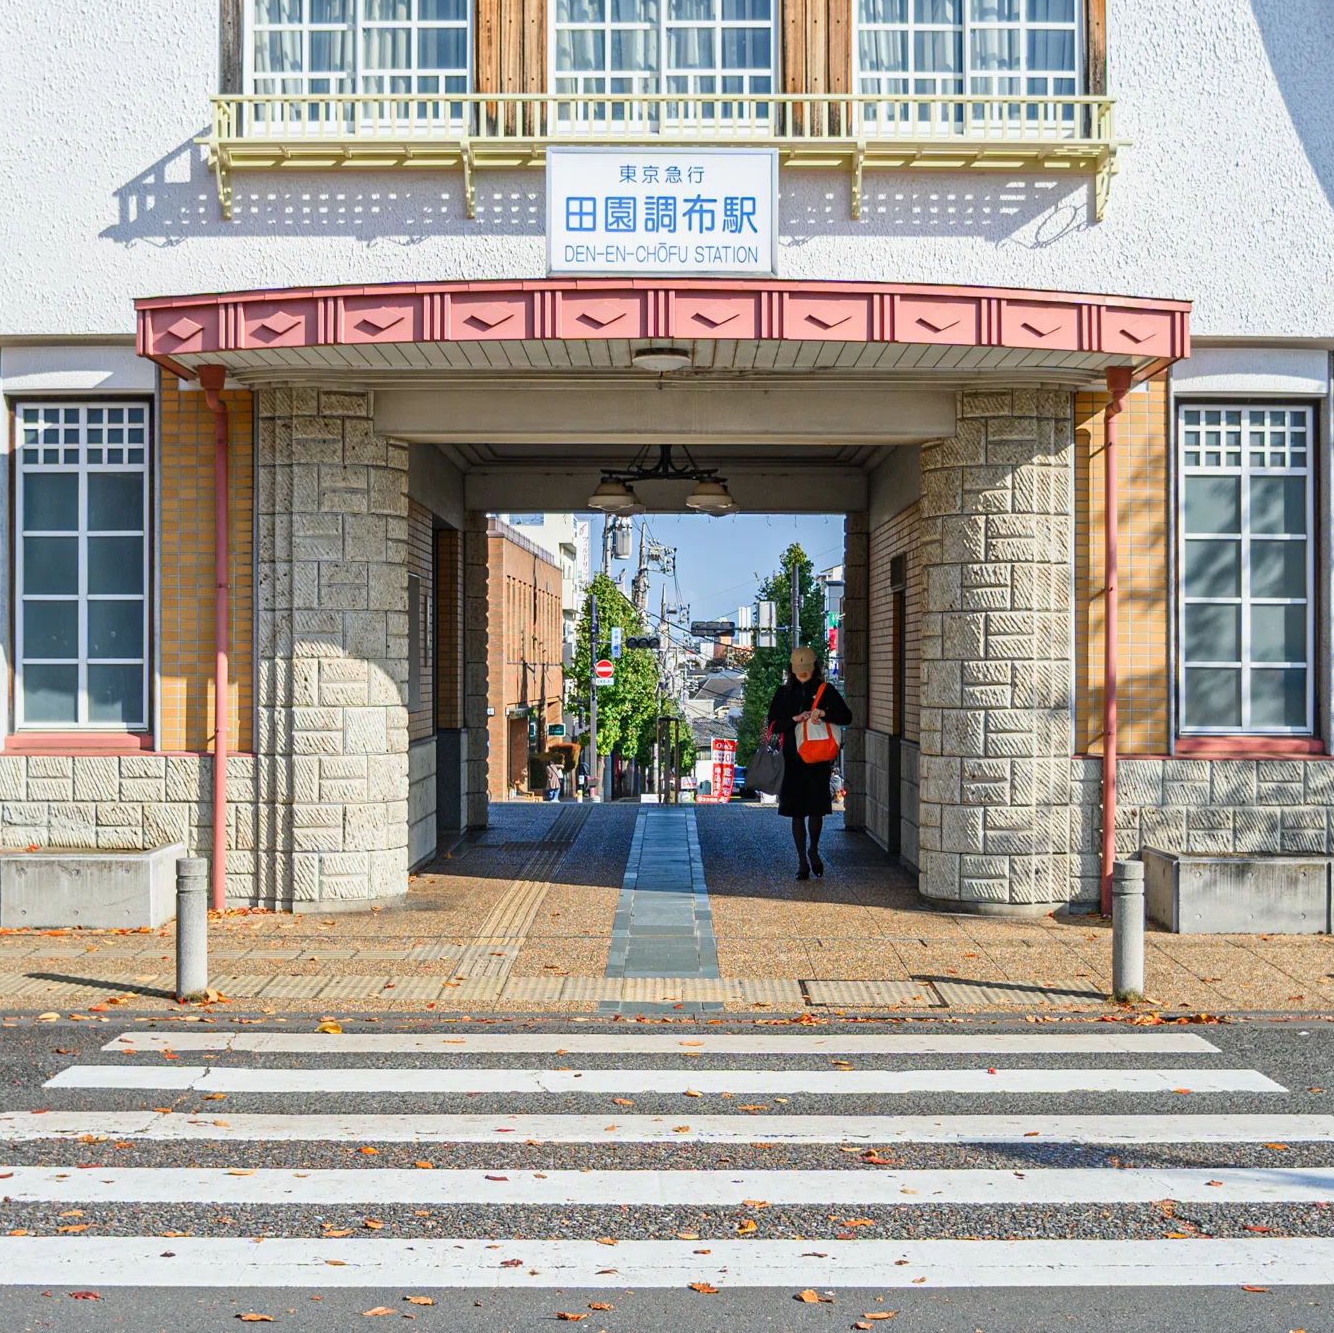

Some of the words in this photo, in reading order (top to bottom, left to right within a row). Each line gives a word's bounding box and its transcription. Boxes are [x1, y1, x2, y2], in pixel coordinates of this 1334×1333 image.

[619, 165, 705, 183] 東京急行
[565, 194, 758, 234] 田園調布駅
[564, 242, 687, 264] DEN-EN-CHŌFU
[694, 245, 758, 264] STATION
